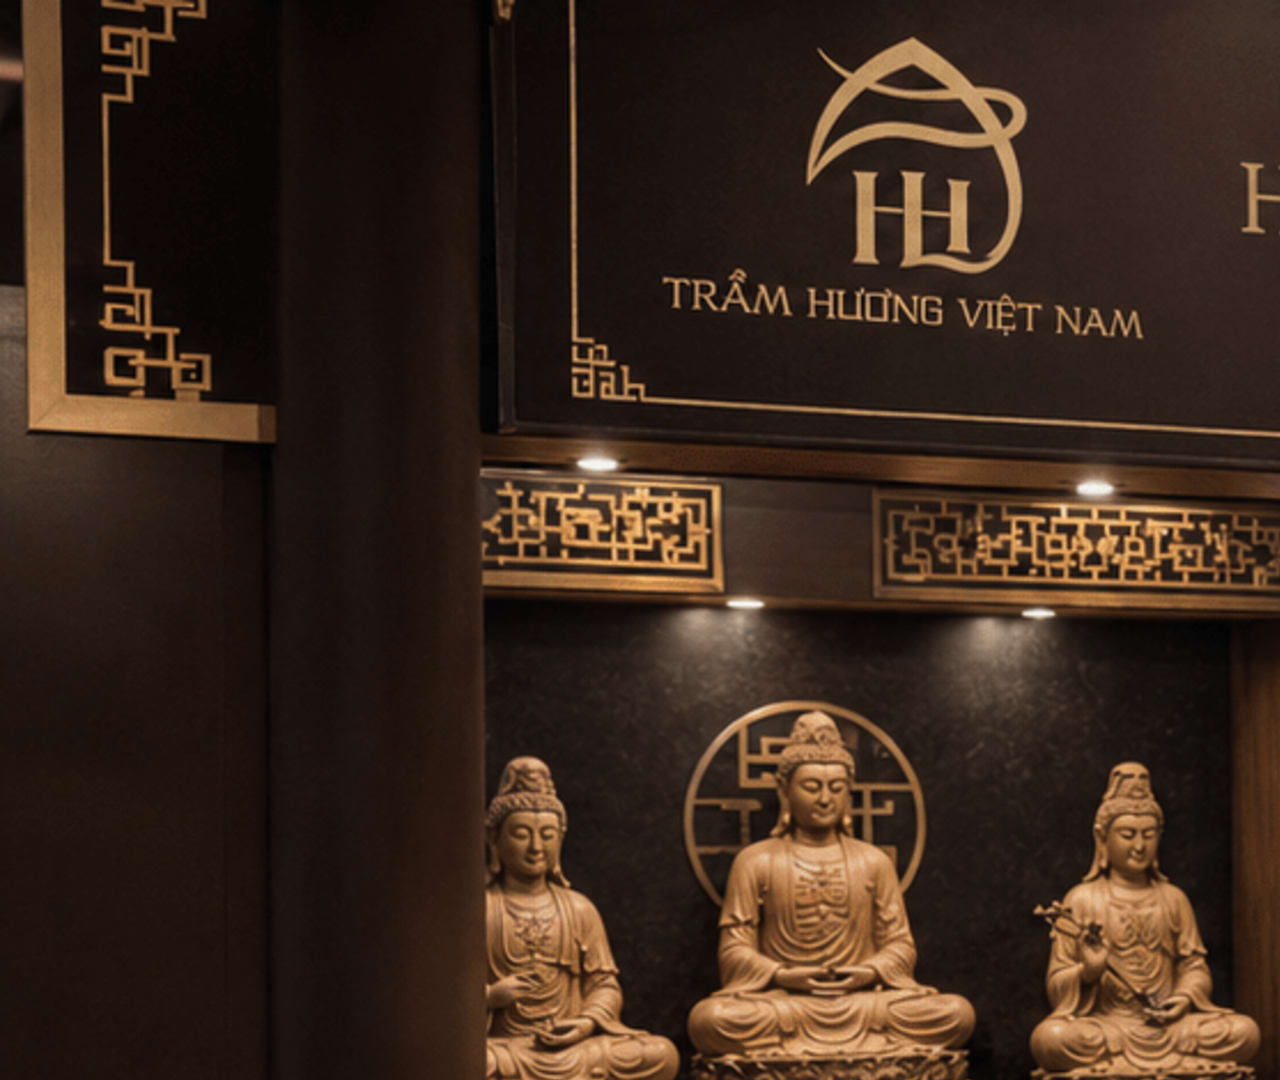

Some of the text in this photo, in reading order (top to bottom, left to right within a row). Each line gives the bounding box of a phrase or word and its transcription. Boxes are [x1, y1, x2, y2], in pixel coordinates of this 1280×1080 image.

[807, 286, 944, 327] HƯƠNG
[956, 292, 1044, 337] VIỆT
[1053, 304, 1145, 340] NAM
